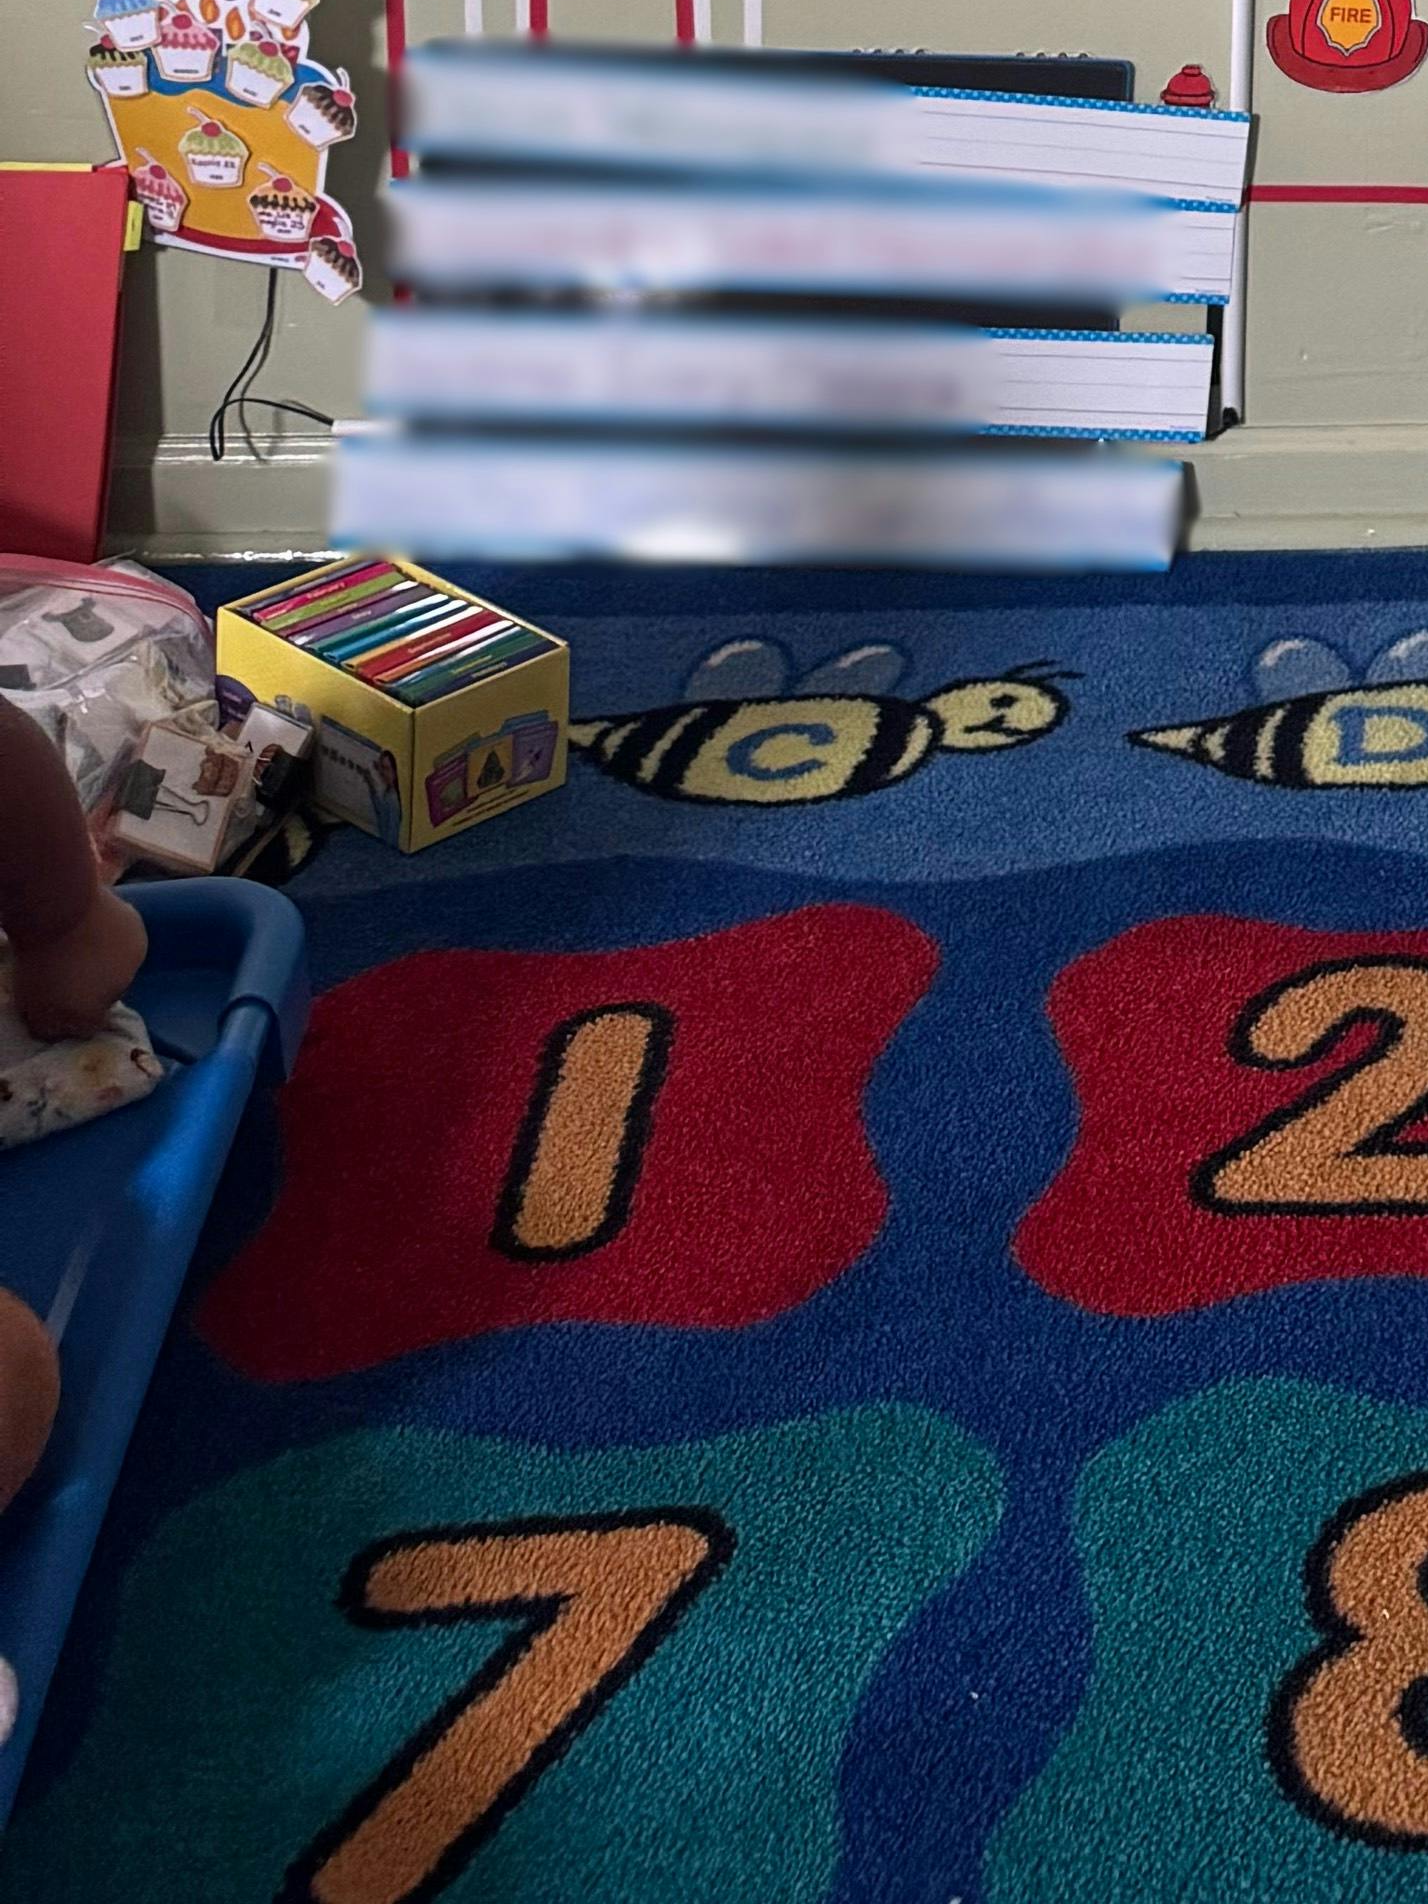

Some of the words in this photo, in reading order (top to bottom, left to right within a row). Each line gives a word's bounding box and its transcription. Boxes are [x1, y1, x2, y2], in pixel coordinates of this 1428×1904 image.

[1330, 6, 1372, 24] FIRE
[726, 722, 836, 782] C
[498, 1001, 676, 1264] 1
[276, 1506, 736, 1904] 7
